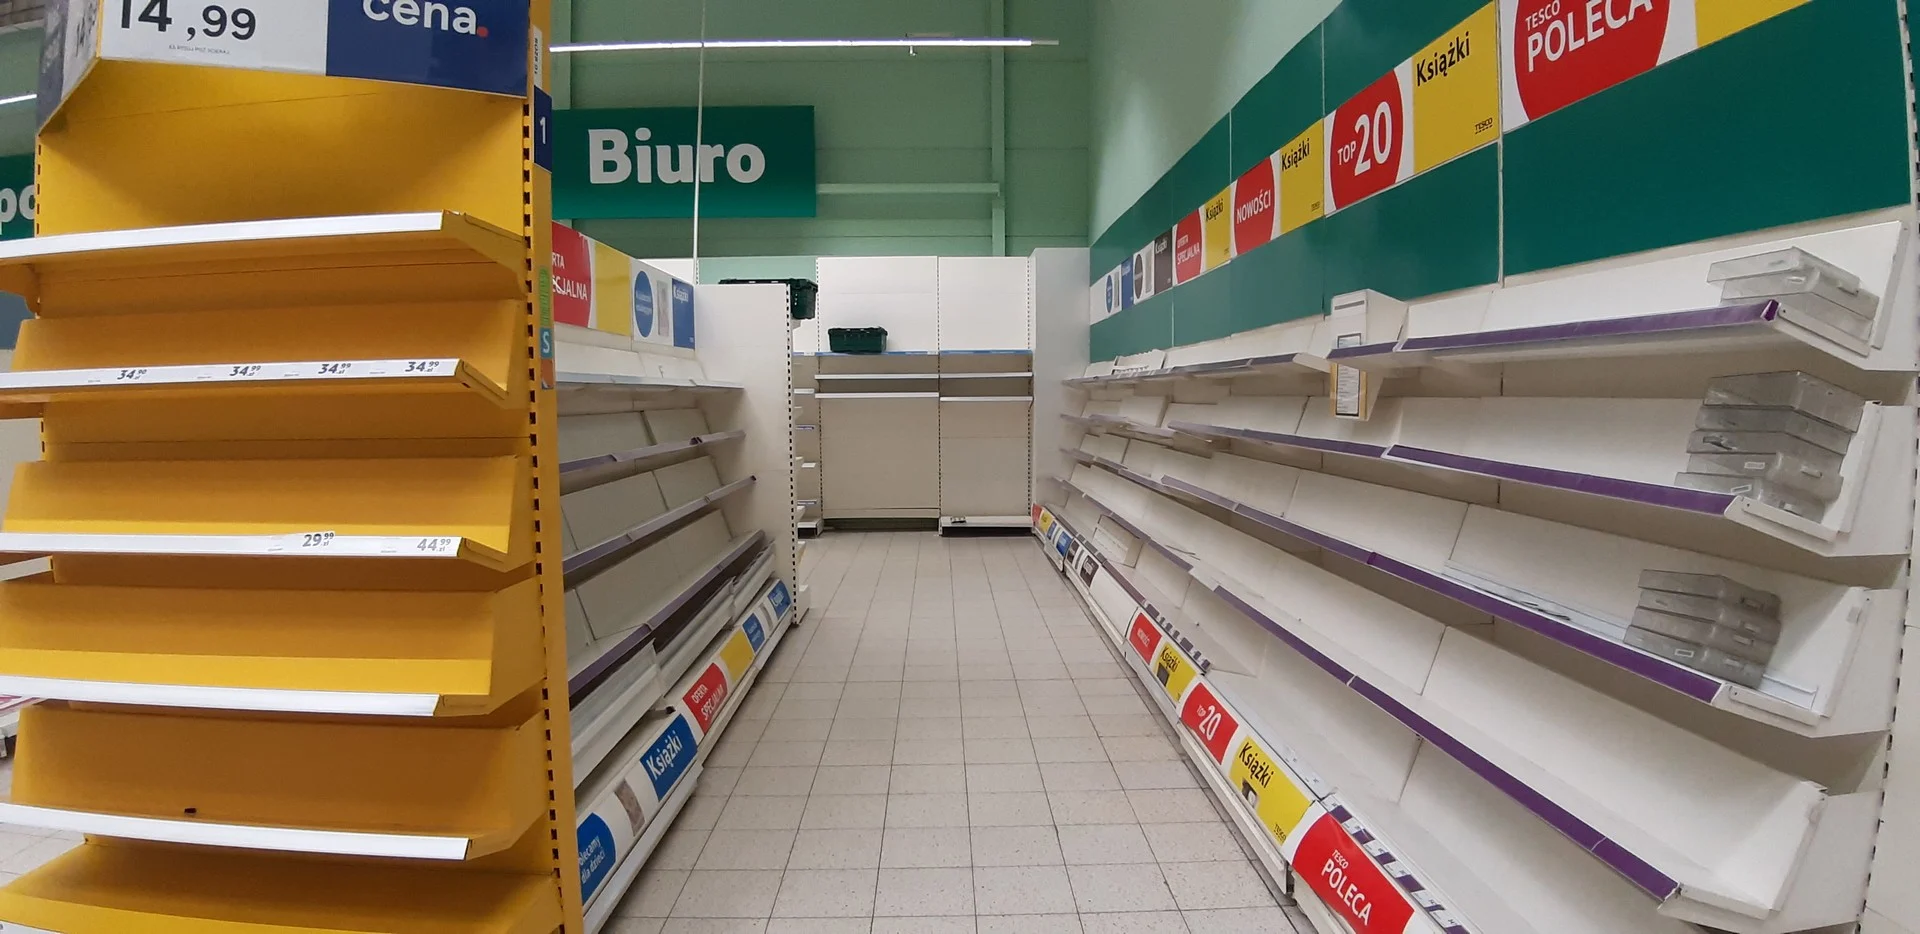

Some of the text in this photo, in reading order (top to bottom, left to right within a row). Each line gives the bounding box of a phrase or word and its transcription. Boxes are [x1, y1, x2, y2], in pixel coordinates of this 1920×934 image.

[1525, 0, 1560, 31] TESCO
[1527, 0, 1653, 72] POLECA
[1417, 31, 1470, 86] Książki
[540, 117, 547, 145] 1
[1337, 101, 1393, 177] TOP 20
[588, 127, 766, 184] Biuro
[1281, 137, 1310, 172] Książki
[1205, 198, 1224, 222] Książki
[1236, 189, 1271, 225] NOWOŚCI
[1160, 645, 1181, 673] Książki
[1198, 705, 1222, 741] 20
[646, 729, 683, 780] Książki
[1238, 742, 1275, 789] Książki
[581, 867, 591, 885] dla
[1331, 849, 1349, 869] TESCO
[1321, 858, 1372, 926] POLECA
